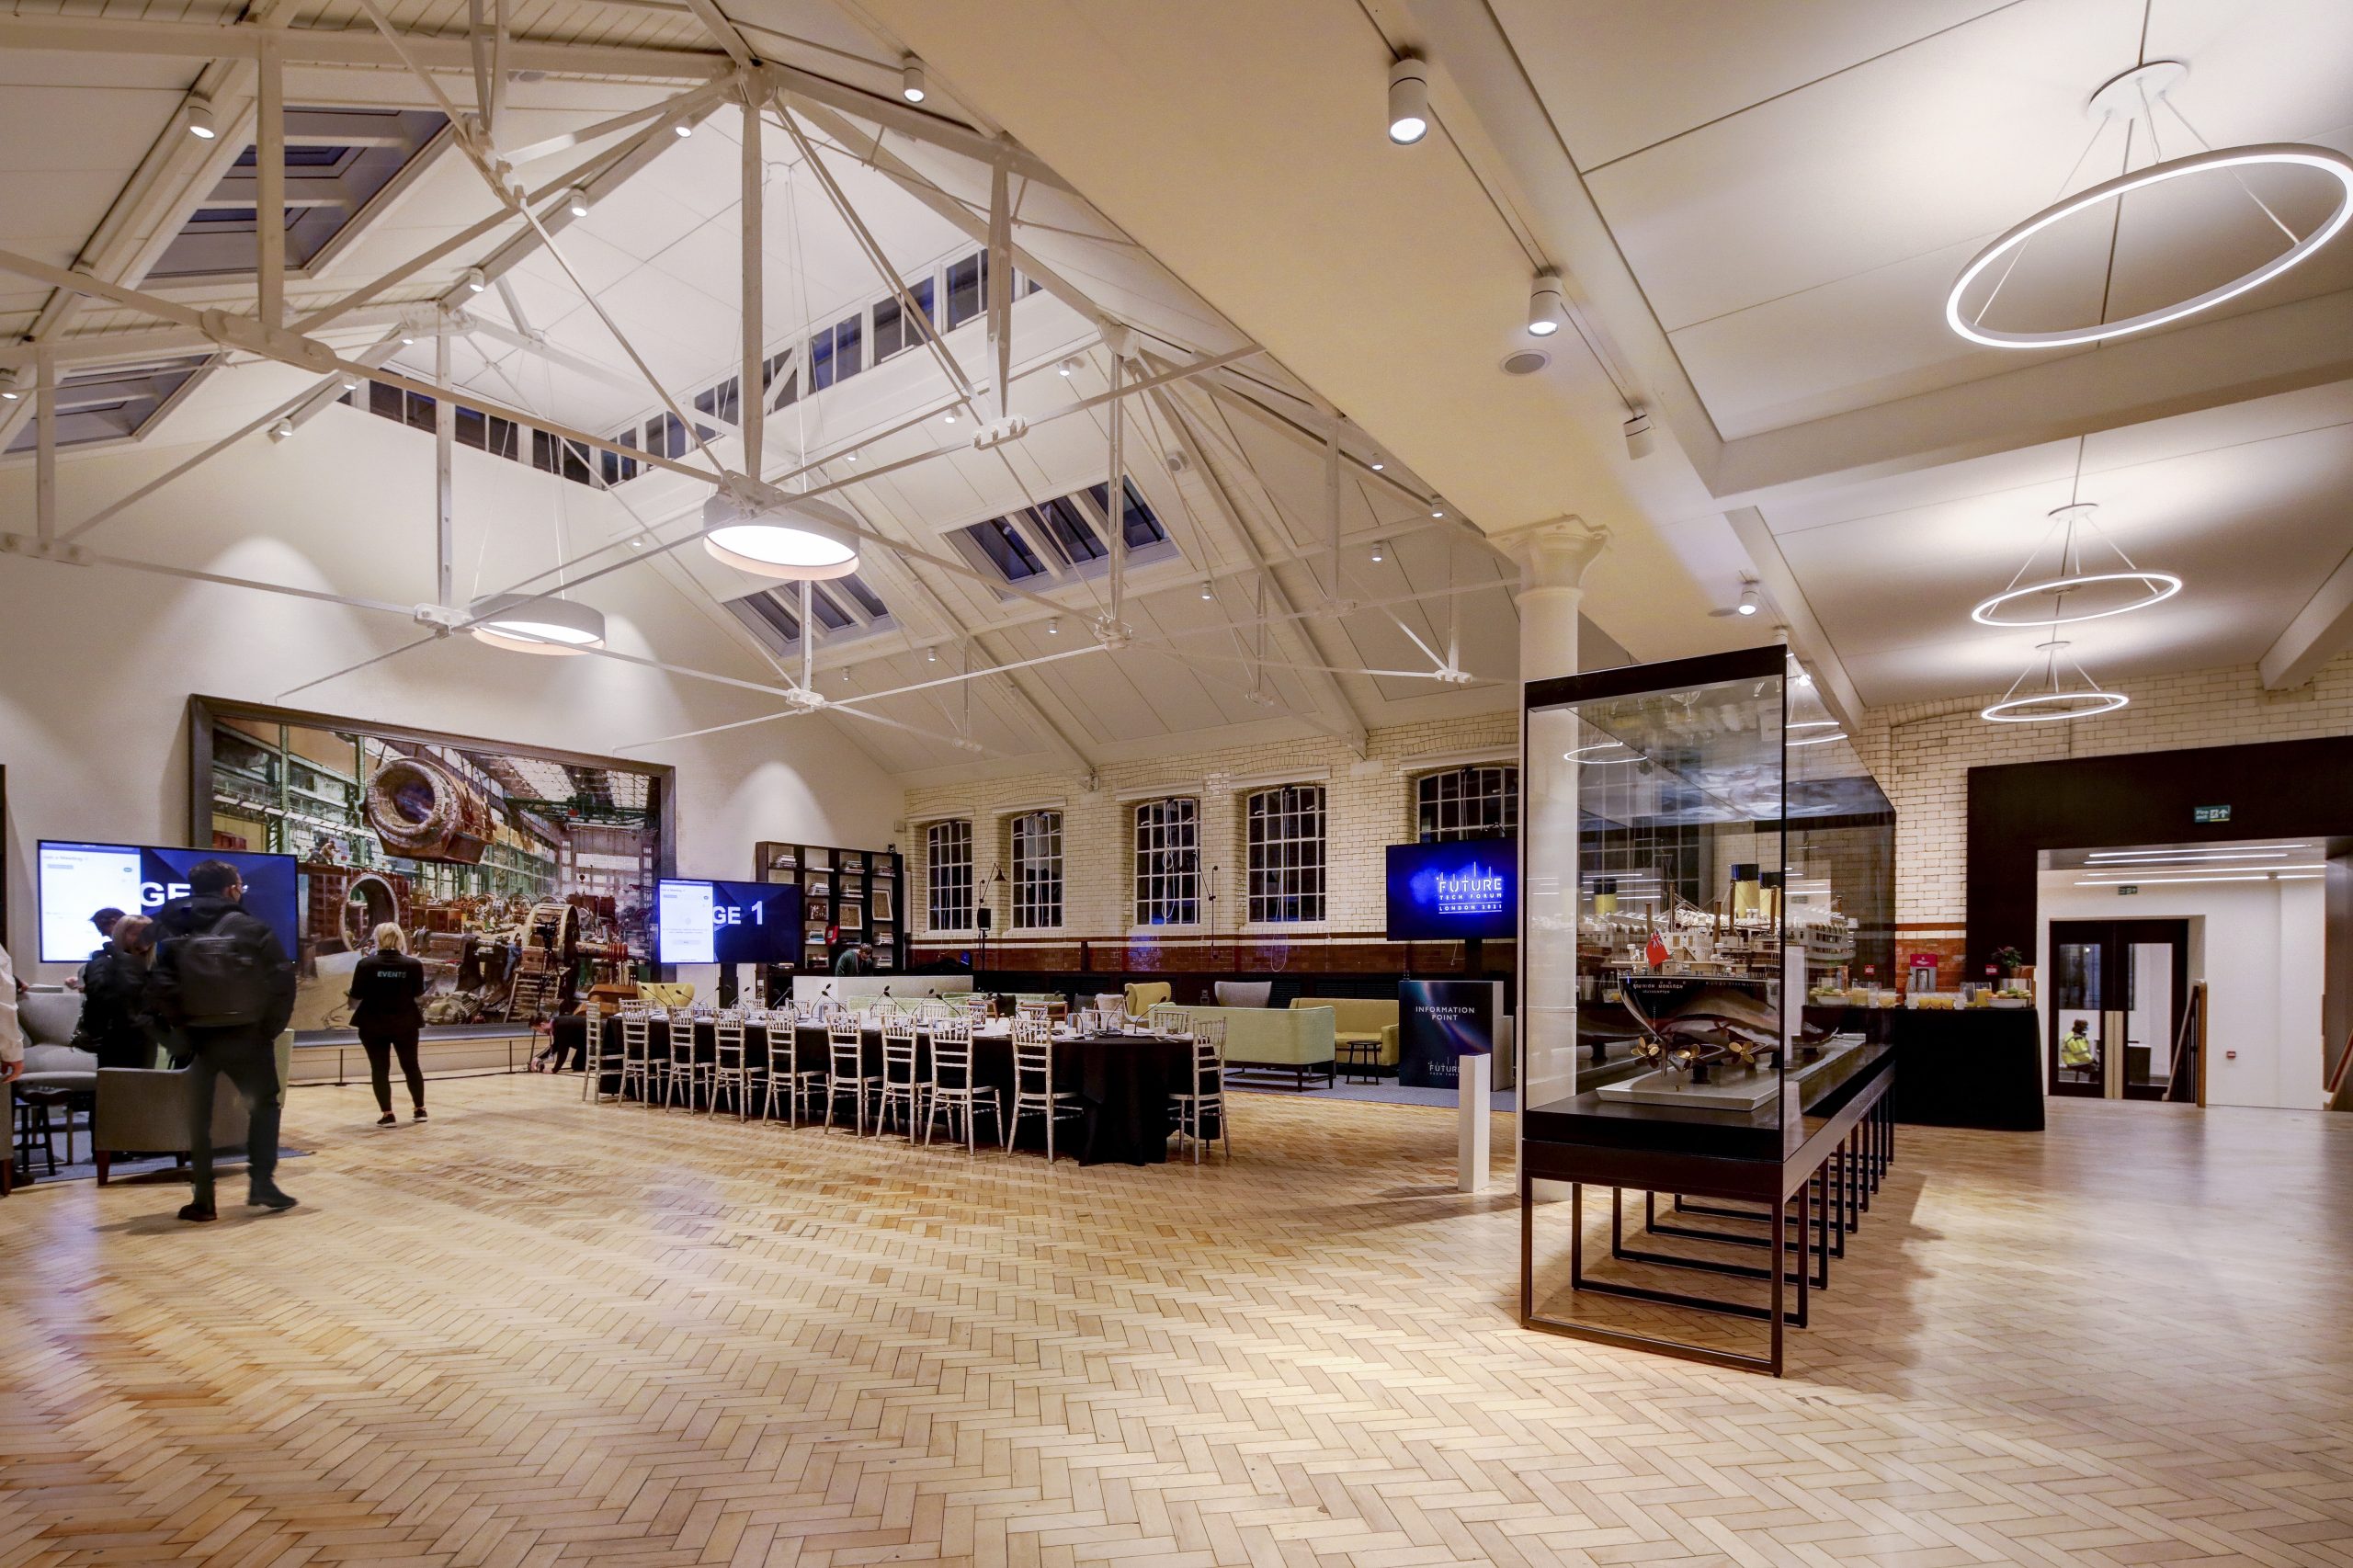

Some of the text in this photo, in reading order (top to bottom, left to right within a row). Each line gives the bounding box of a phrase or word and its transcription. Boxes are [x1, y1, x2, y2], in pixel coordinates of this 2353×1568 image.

[1438, 873, 1502, 893] FUTURE
[751, 901, 763, 925] 1
[1415, 1006, 1475, 1014] INFORMATION
